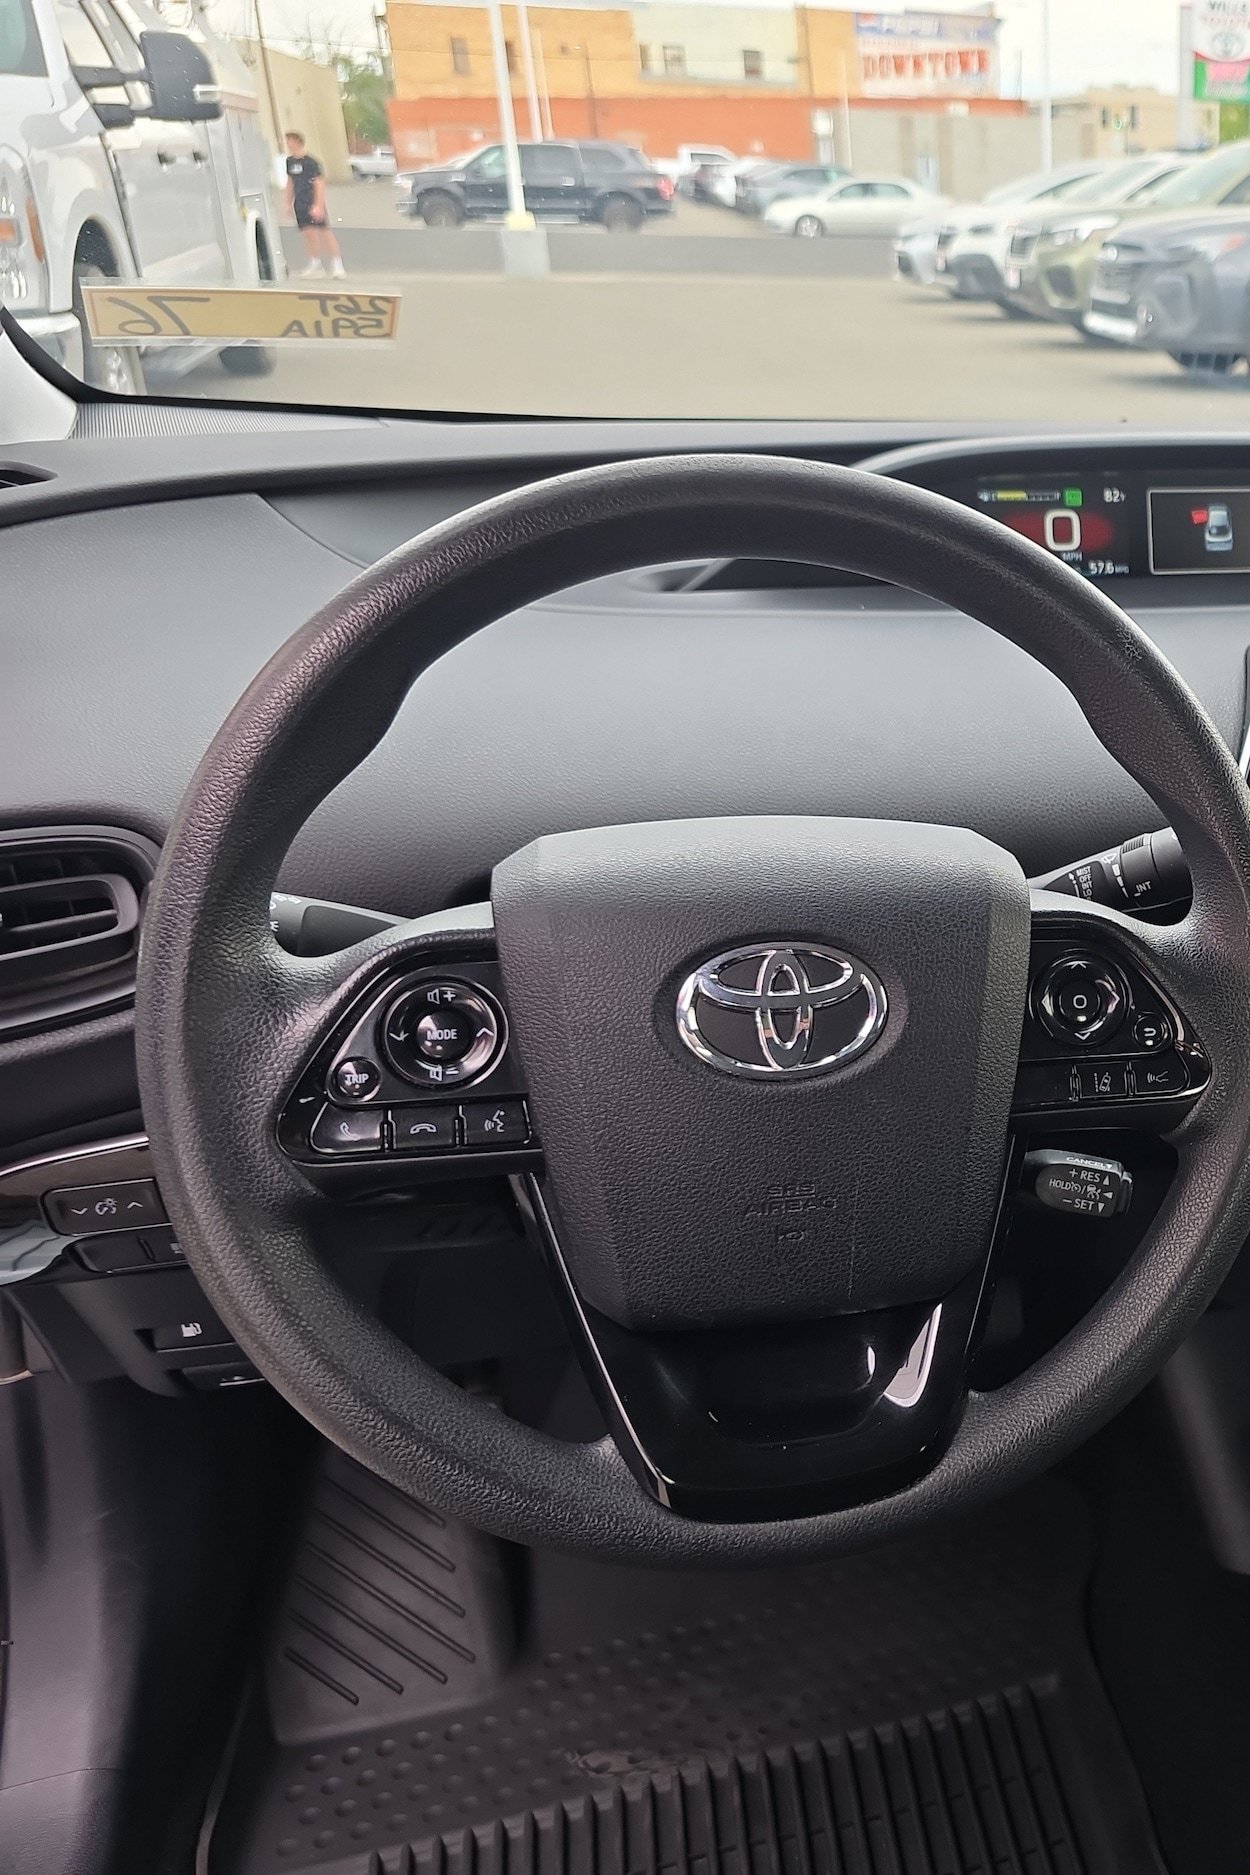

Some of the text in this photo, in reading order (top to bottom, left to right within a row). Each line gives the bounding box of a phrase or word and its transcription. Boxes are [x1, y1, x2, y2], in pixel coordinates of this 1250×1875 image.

[1062, 553, 1082, 562] MPH
[1076, 866, 1091, 876] MIST
[1079, 874, 1092, 882] OFF
[1081, 881, 1092, 889] INT
[1136, 881, 1152, 892] INT
[1083, 889, 1092, 897] LO
[426, 1029, 458, 1040] MODE
[345, 1073, 369, 1084] TRIP
[1066, 1156, 1106, 1169] CANCEL
[1080, 1170, 1102, 1183] RES
[1048, 1178, 1071, 1191] HOLD
[1074, 1198, 1096, 1211] SET
